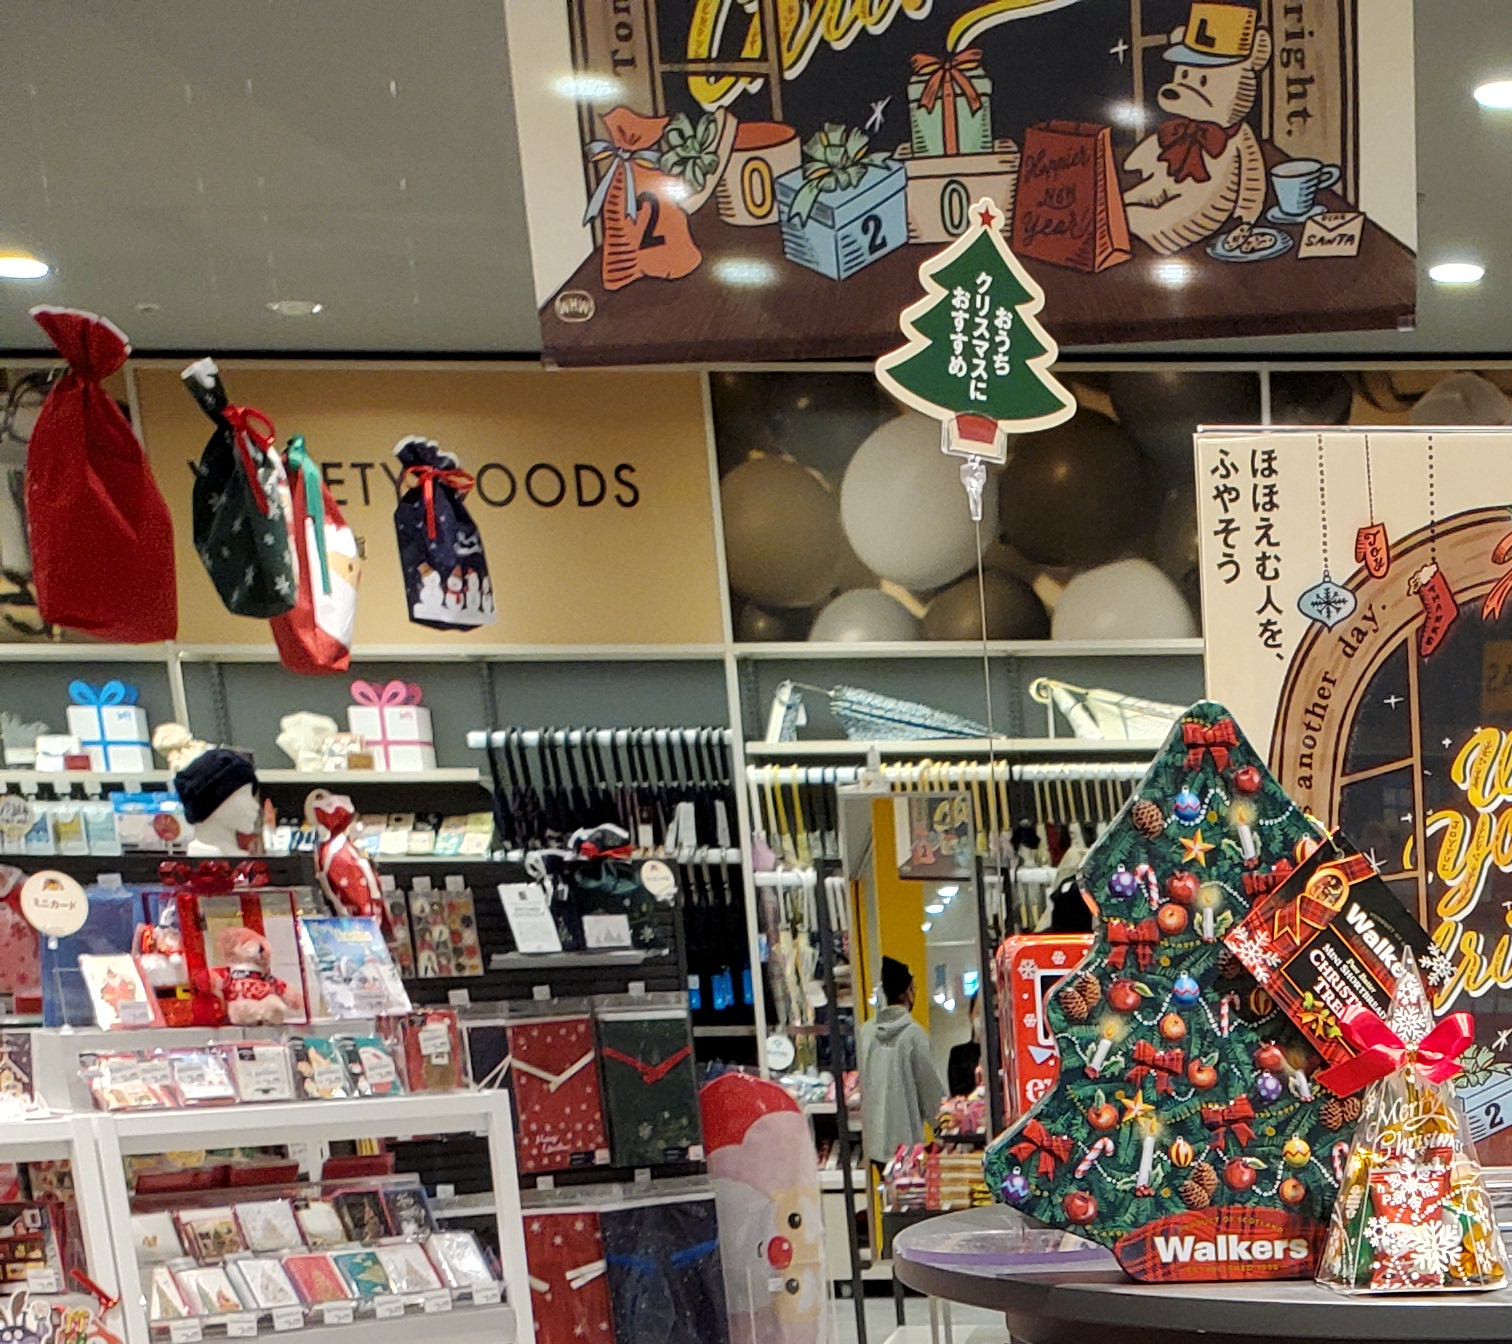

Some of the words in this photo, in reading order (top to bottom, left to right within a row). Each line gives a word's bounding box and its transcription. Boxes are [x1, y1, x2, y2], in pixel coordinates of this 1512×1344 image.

[636, 191, 666, 249] 2
[741, 156, 774, 220] 0
[861, 214, 887, 254] 2
[1304, 233, 1356, 248] SANTA
[948, 286, 971, 377] おすすめ
[968, 271, 993, 401] クリスマスに
[994, 306, 1013, 376] おうち
[476, 462, 640, 508] OODS
[1209, 447, 1242, 585] ふやそう
[1250, 447, 1285, 661] ほほえむ人を、
[1338, 603, 1387, 658] day.
[1297, 671, 1338, 790] another
[1153, 1235, 1309, 1264] Walkers
